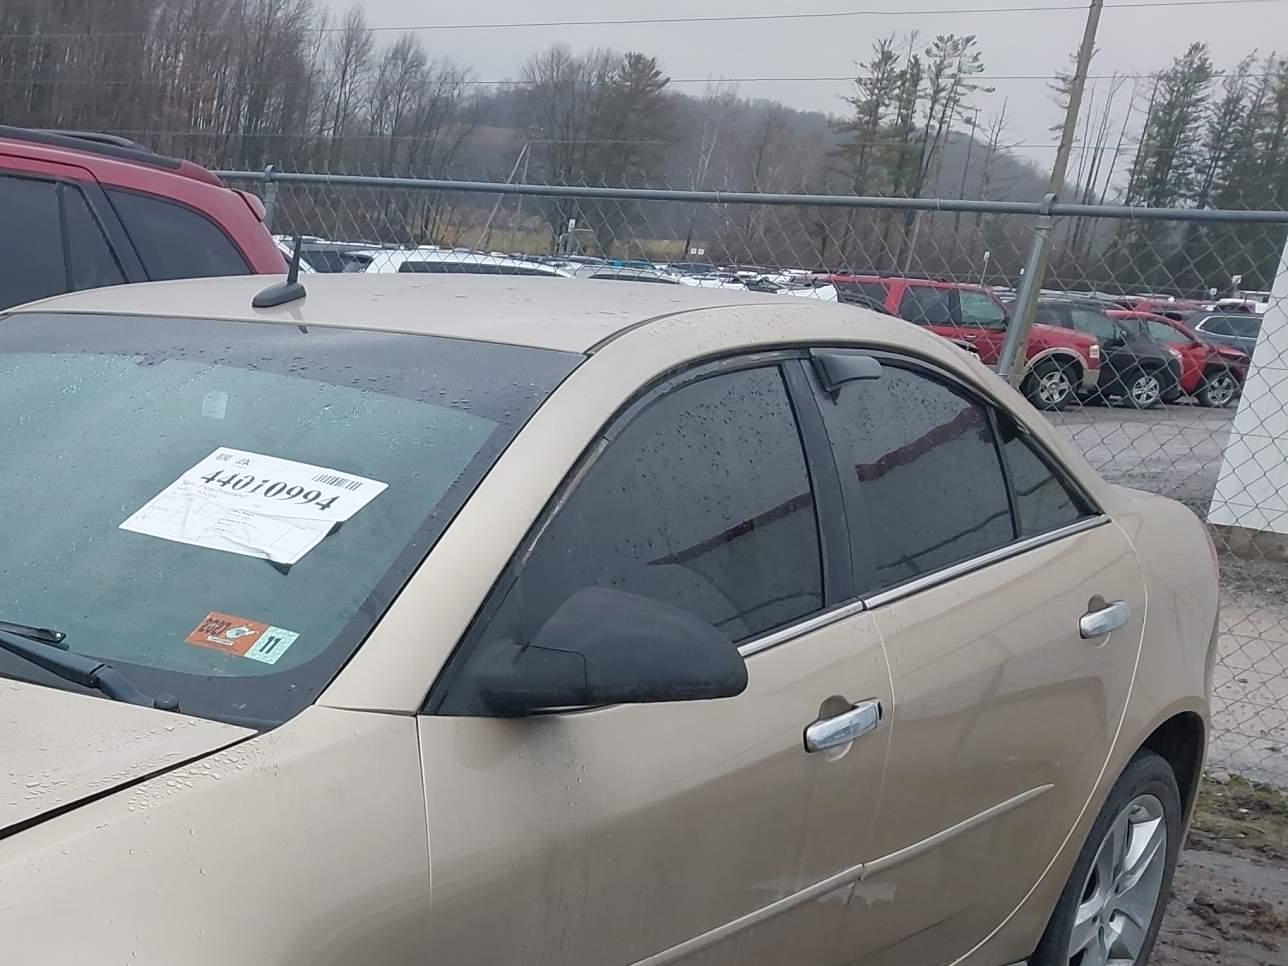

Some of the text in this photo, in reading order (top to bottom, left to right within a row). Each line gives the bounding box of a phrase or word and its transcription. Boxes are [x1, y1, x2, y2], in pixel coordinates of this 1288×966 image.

[200, 469, 340, 511] 44010994
[198, 618, 232, 635] 2027
[259, 636, 282, 654] 11
